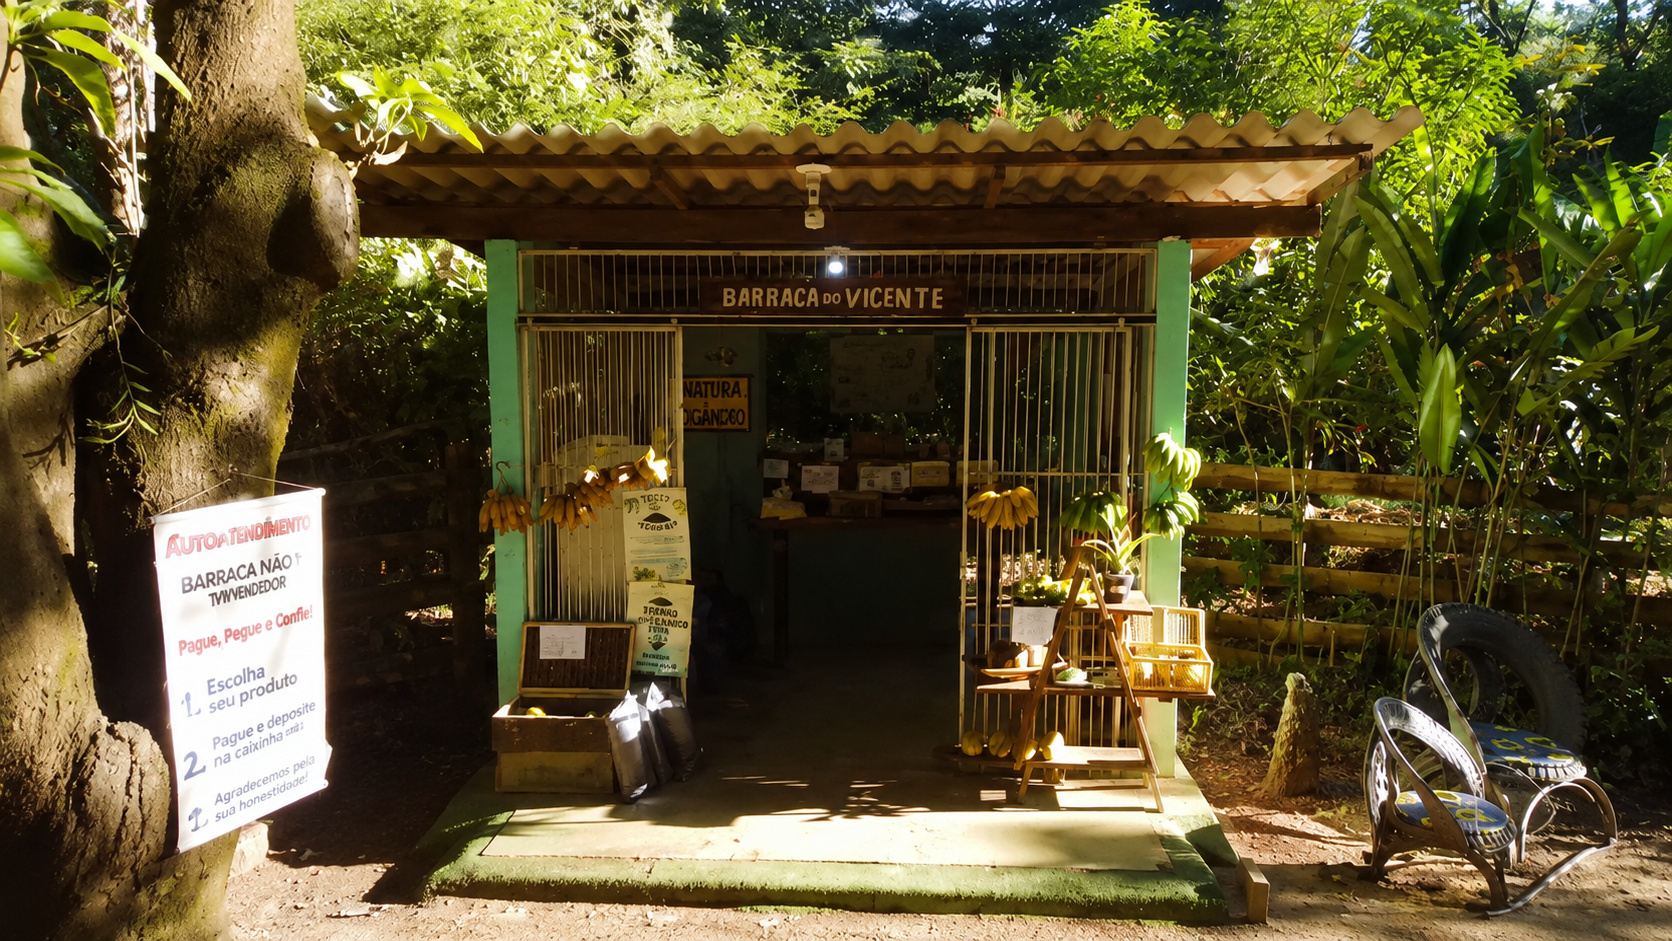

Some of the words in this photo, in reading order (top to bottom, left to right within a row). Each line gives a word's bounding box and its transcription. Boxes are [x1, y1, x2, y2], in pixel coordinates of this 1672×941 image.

[722, 287, 819, 307] BARRACA
[823, 292, 841, 305] DO
[845, 287, 944, 310] VICENTE
[166, 515, 311, 558] AUTOATENDIMENTO
[181, 562, 257, 594] BARRACA
[260, 553, 292, 575] NÃO
[178, 635, 222, 656] Pague,
[224, 622, 262, 643] Pegue
[265, 619, 273, 631] e
[275, 604, 313, 628] Confie!
[206, 666, 265, 695] Escolha
[209, 695, 235, 714] seu
[239, 673, 297, 707] produto
[212, 726, 254, 750] Pague
[256, 722, 264, 733] e
[267, 701, 316, 729] deposite
[183, 751, 207, 781] 2
[214, 753, 231, 768] na
[235, 731, 283, 759] caixinha
[214, 766, 290, 806] Agradecemos
[293, 755, 315, 775] pela
[215, 806, 236, 823] sua
[239, 771, 309, 812] honestidade!
